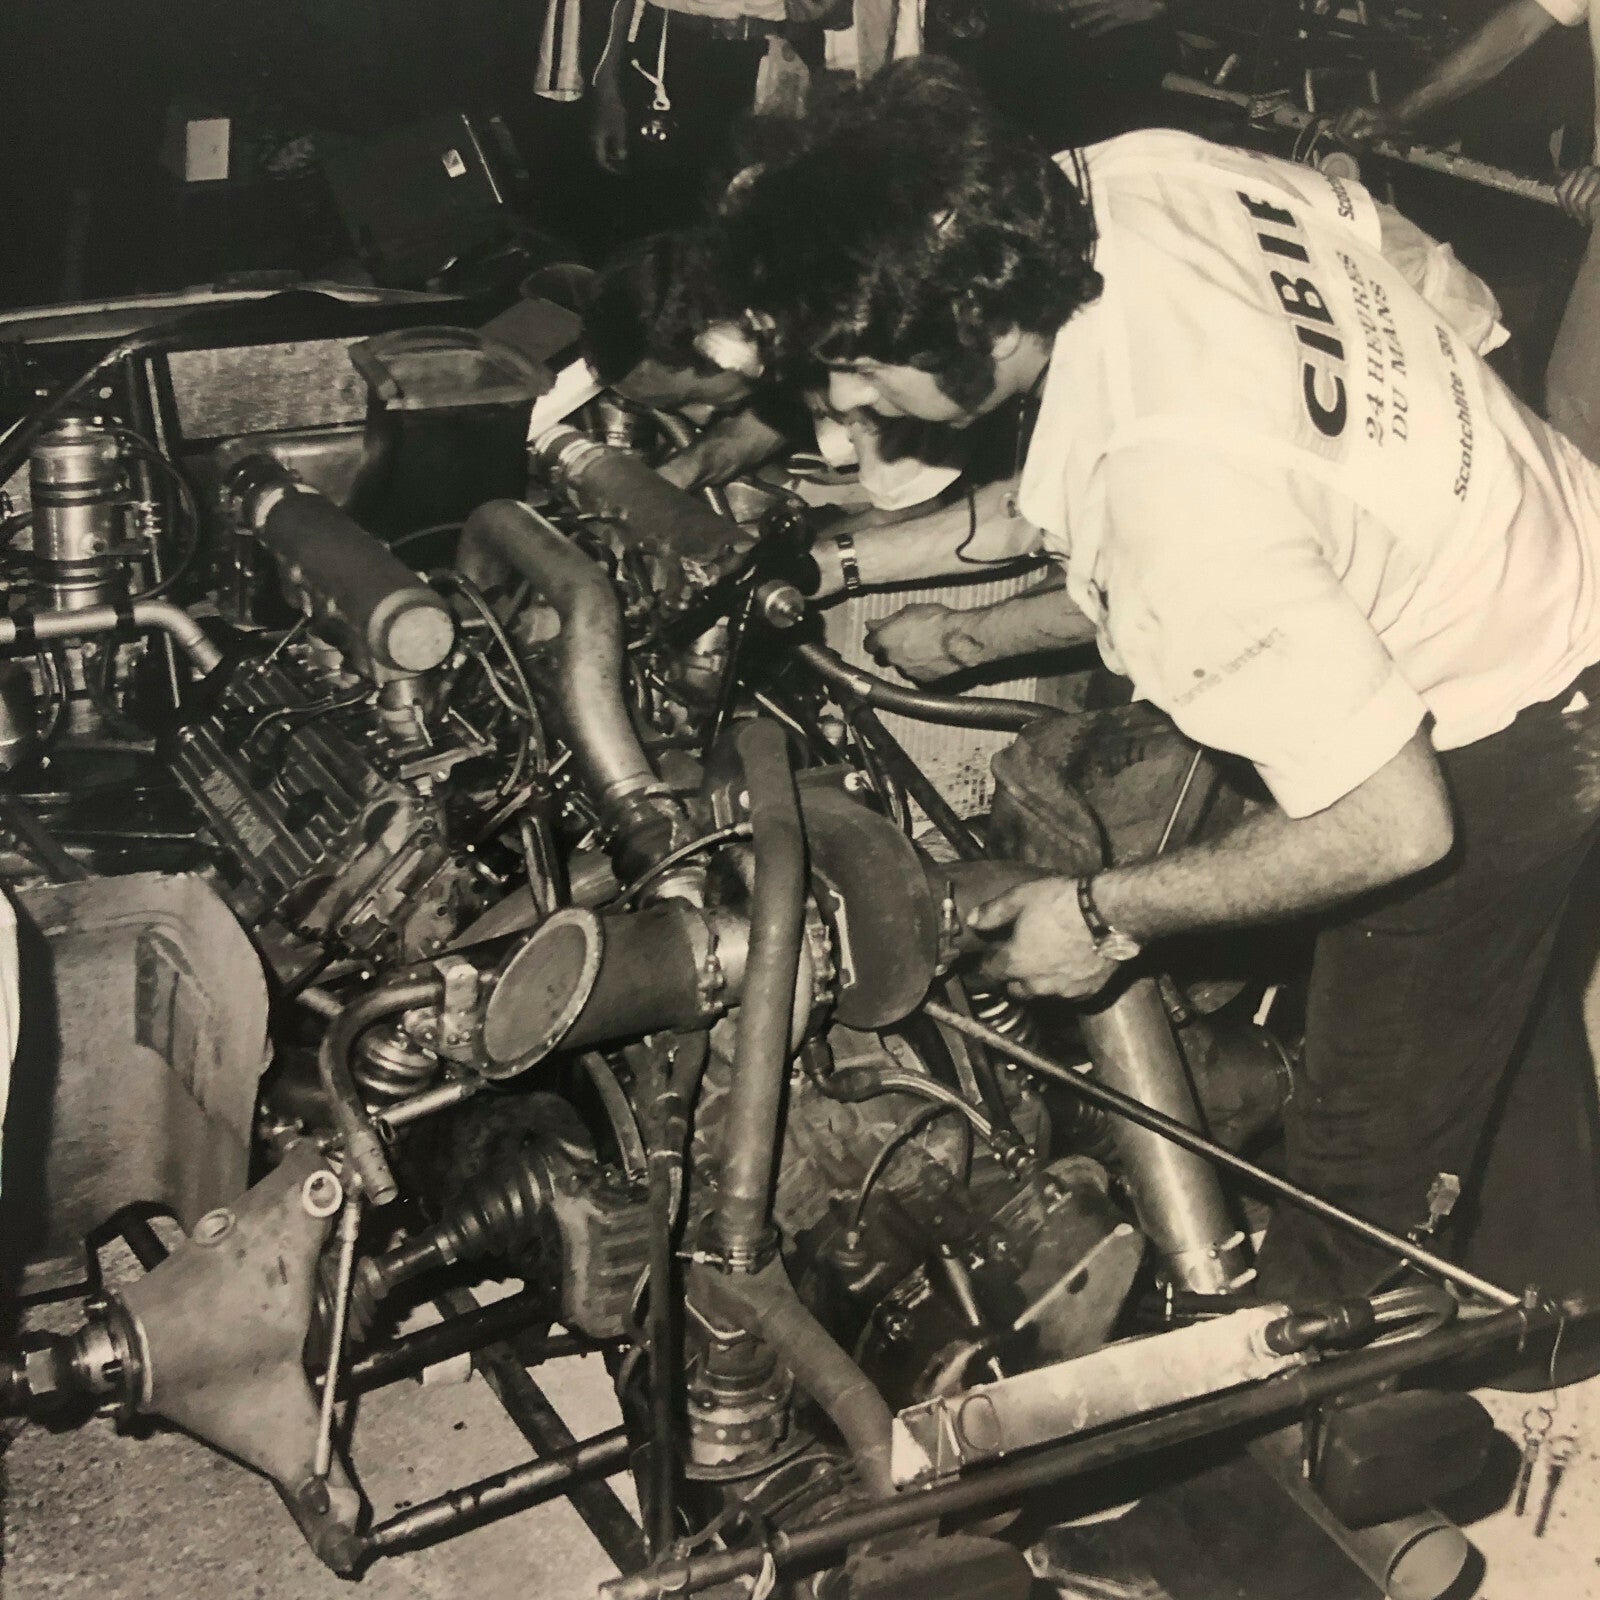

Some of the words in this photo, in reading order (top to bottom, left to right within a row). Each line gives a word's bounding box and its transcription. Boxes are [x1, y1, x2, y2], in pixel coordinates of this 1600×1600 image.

[1336, 251, 1384, 384] HEURES
[1369, 280, 1408, 378] MANS
[1366, 393, 1384, 447] 24
[1392, 385, 1408, 442] DU
[1450, 371, 1474, 502] Scotchlite
